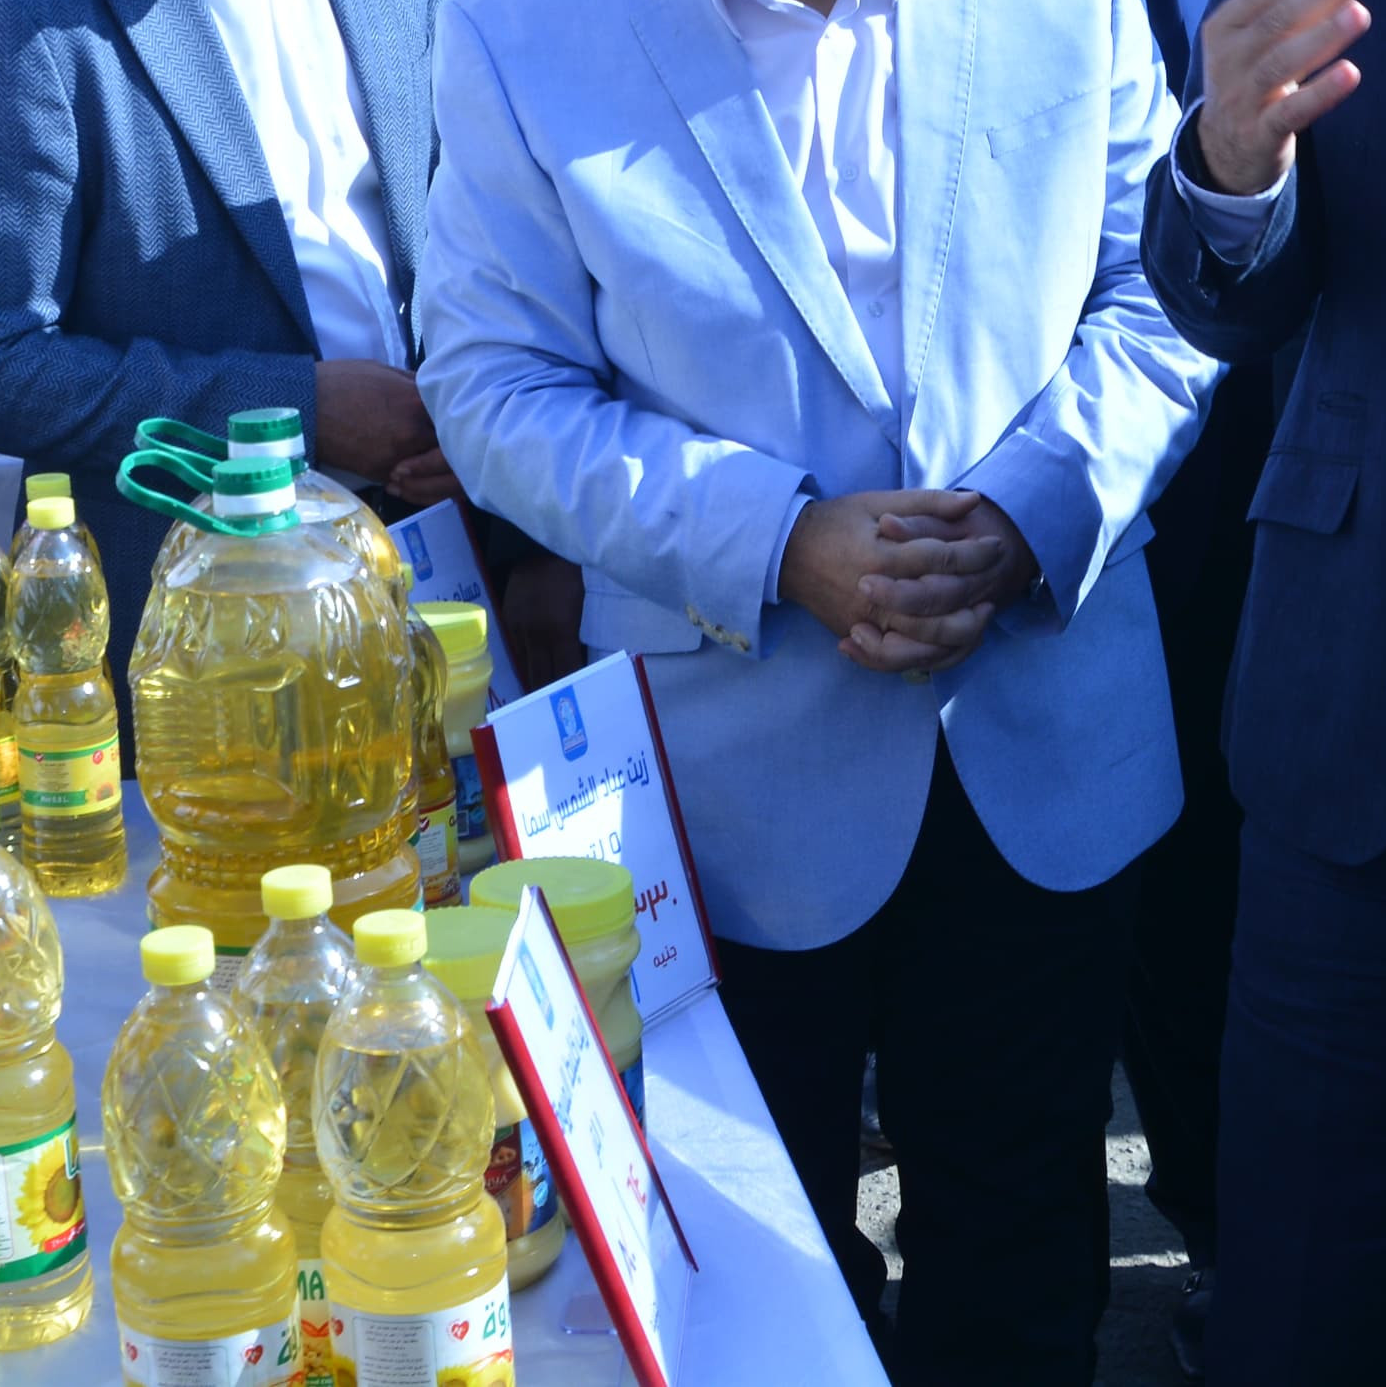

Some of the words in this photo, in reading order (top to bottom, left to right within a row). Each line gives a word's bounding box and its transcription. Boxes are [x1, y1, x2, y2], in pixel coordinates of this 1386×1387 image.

[627, 751, 649, 786] زيت
[599, 768, 626, 799] عباد
[554, 776, 598, 831] الشمس
[521, 810, 551, 837] سما
[585, 839, 604, 860] لت
[653, 944, 678, 968] جنيه
